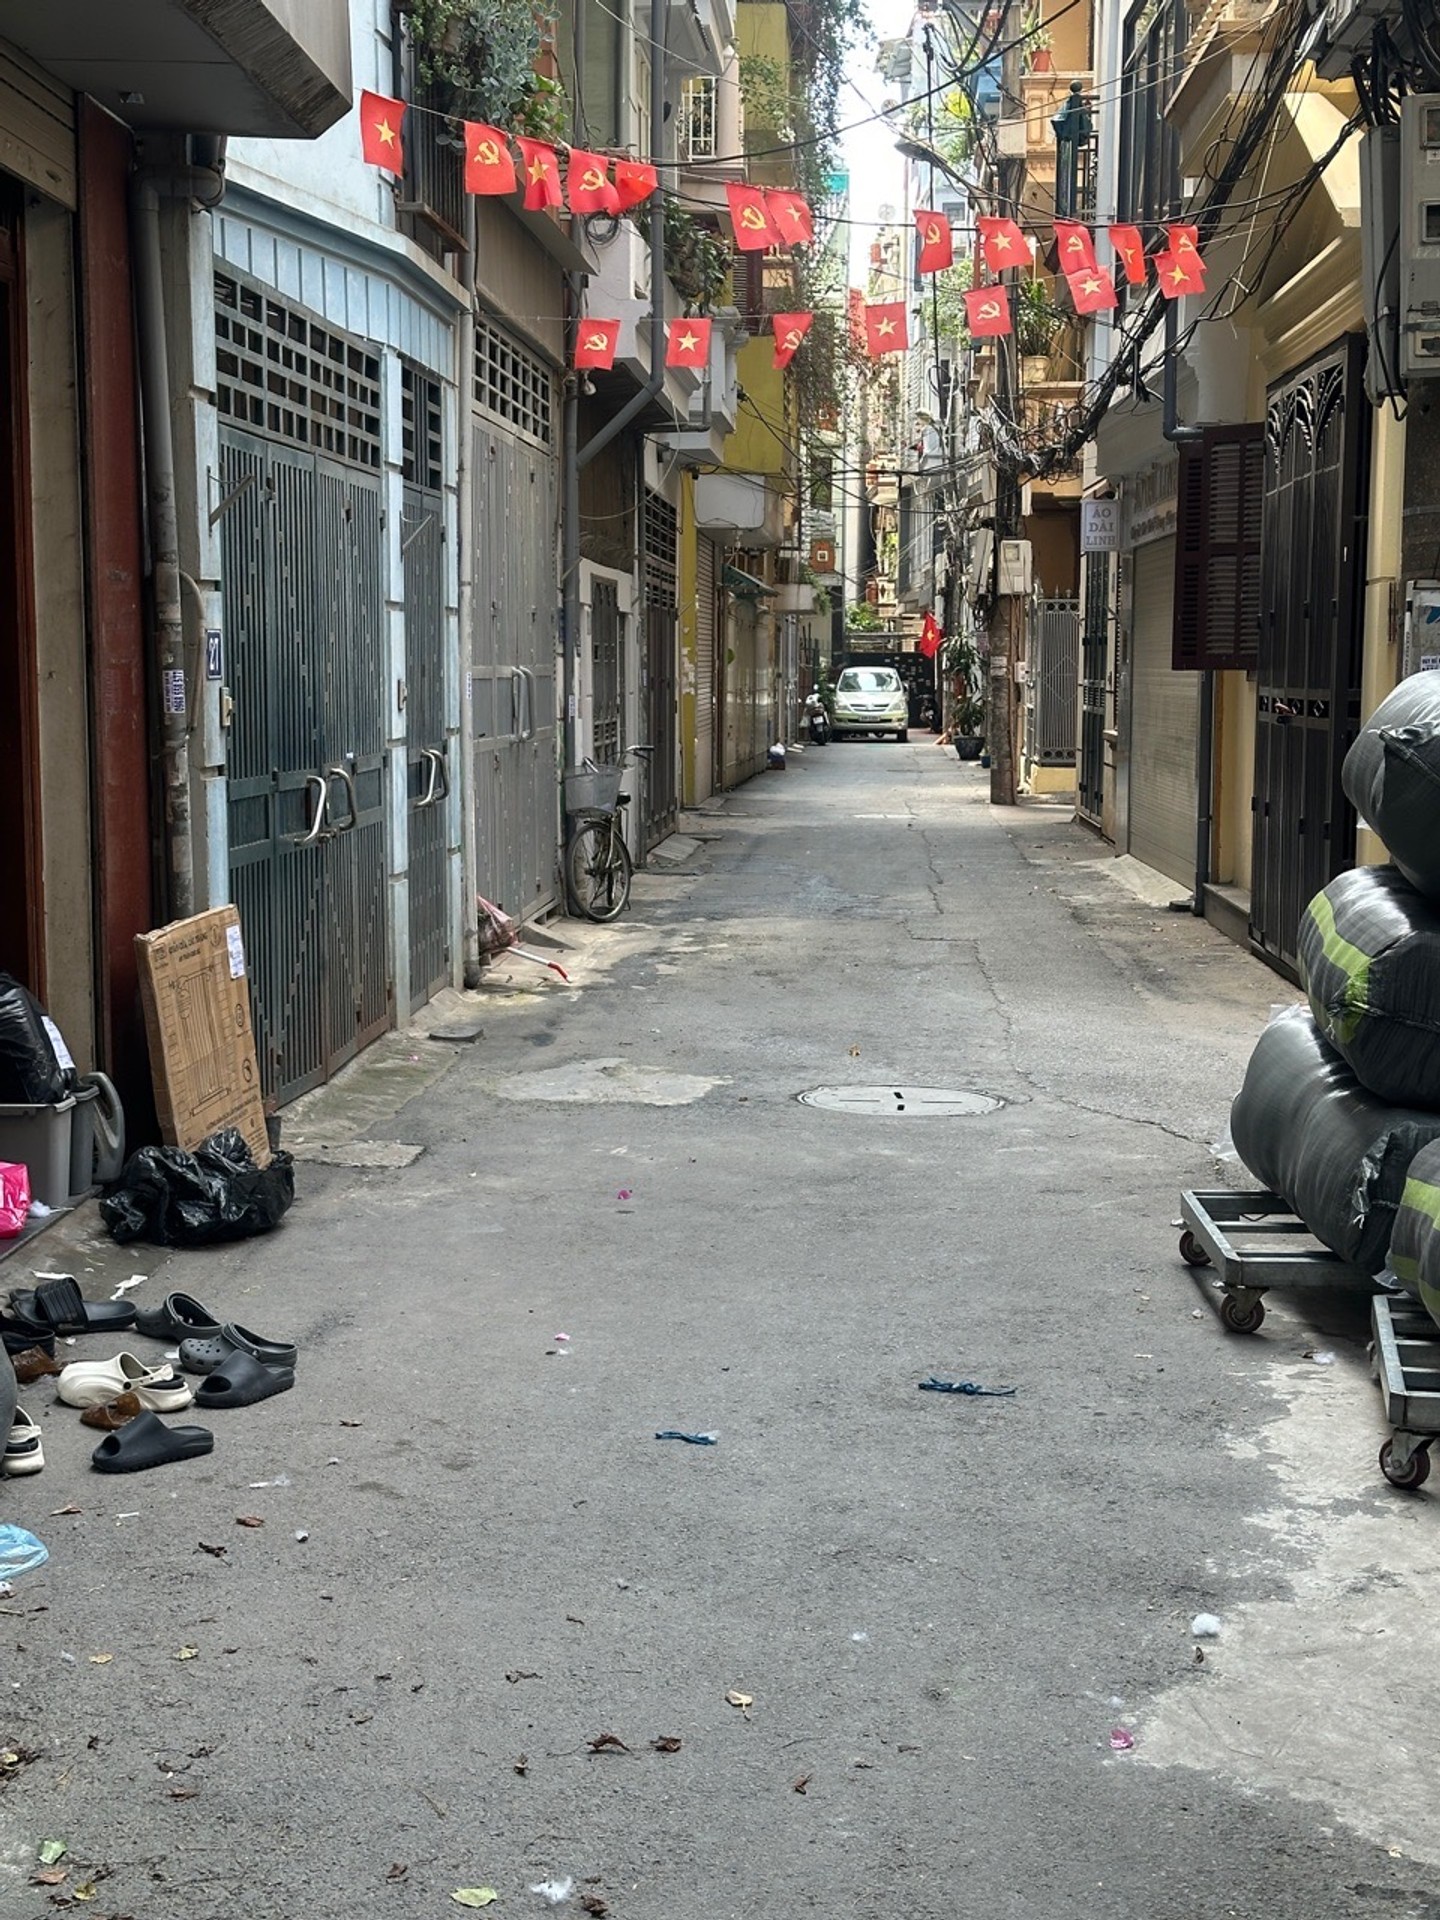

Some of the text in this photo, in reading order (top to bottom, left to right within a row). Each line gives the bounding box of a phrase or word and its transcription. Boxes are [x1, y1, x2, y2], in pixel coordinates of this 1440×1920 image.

[1092, 505, 1112, 518] ÁO
[1089, 519, 1114, 532] DÀI
[1086, 536, 1116, 546] LINH
[208, 637, 219, 670] 27
